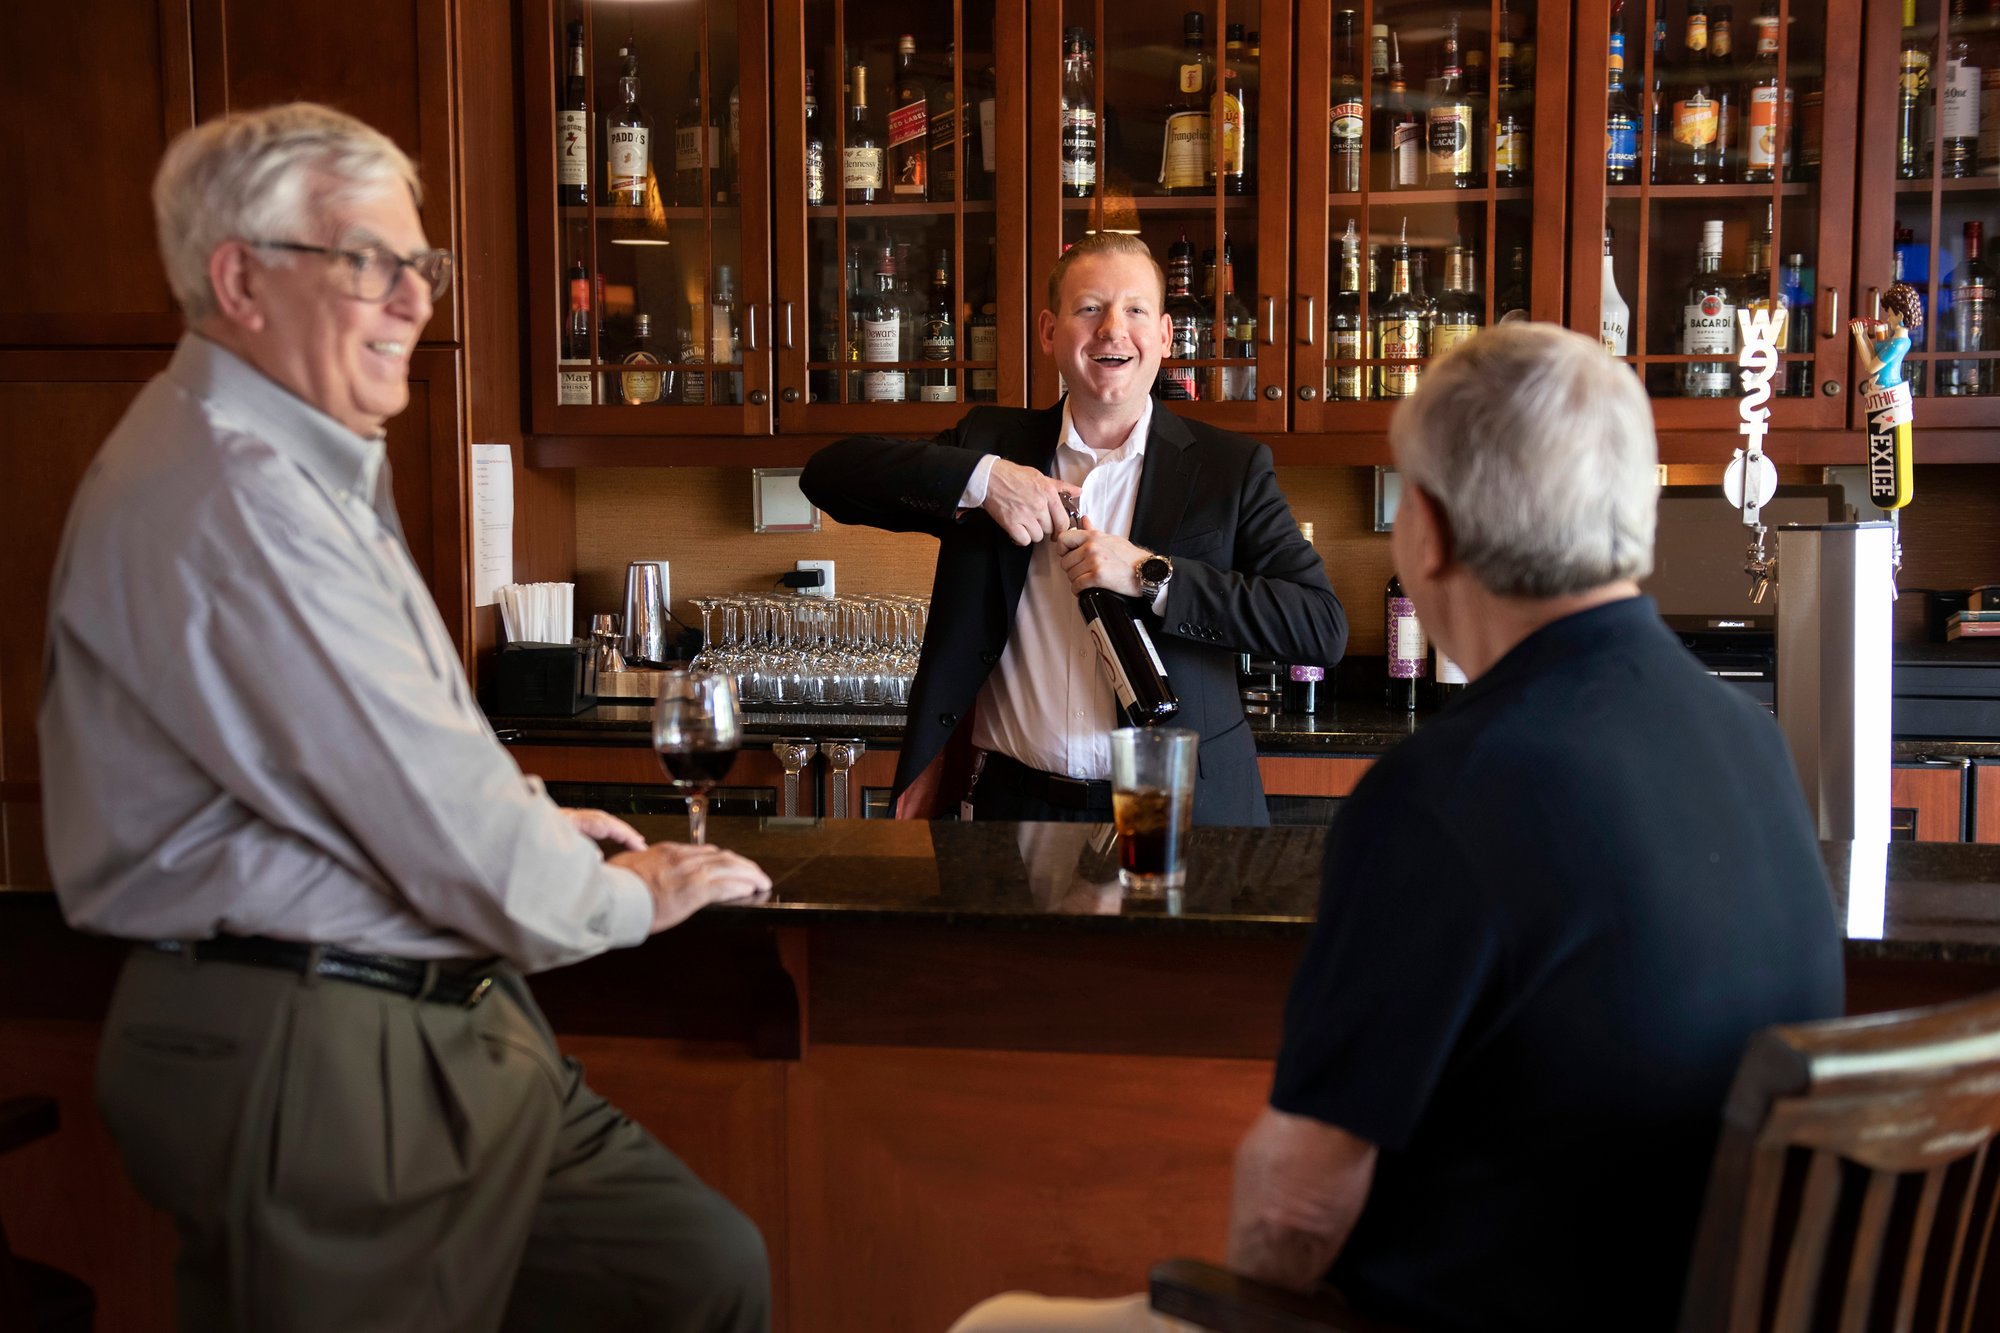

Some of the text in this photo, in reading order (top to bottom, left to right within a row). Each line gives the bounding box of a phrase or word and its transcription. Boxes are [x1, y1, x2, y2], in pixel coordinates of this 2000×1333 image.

[1330, 105, 1363, 117] BAILEY
[889, 121, 903, 130] RED
[904, 112, 926, 124] LABEL
[566, 135, 578, 156] 7
[1063, 139, 1096, 147] AMARETT
[1690, 316, 1731, 328] BACARDÍ
[866, 328, 897, 338] Dewar's
[565, 374, 591, 382] Mar
[1865, 390, 1899, 410] UTHIE
[1870, 433, 1896, 497] EXILE
